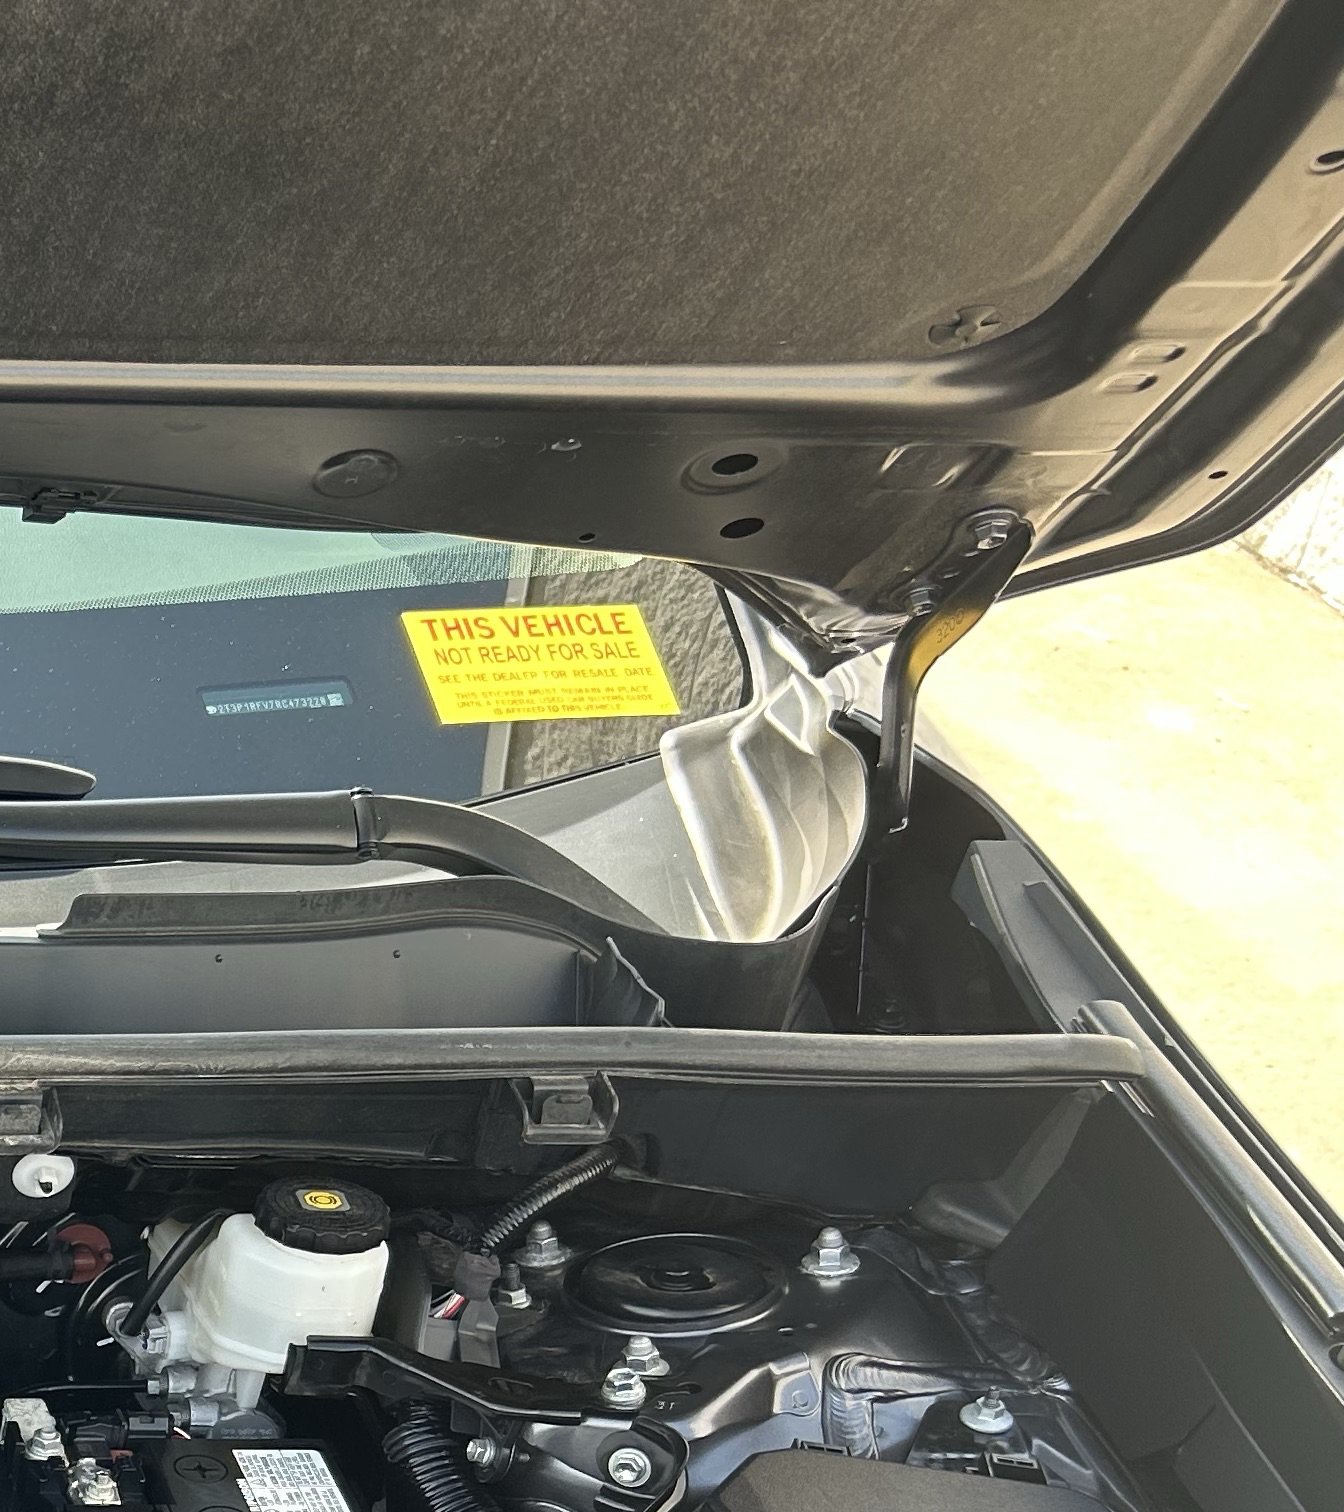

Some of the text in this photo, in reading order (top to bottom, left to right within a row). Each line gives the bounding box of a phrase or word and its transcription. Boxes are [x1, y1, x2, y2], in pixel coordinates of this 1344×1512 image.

[420, 612, 633, 641] THIS VEHICLE
[433, 641, 640, 666] NOT READY FOR SALE
[438, 667, 654, 684] SEE THE DEALER FOR RESALE DATE
